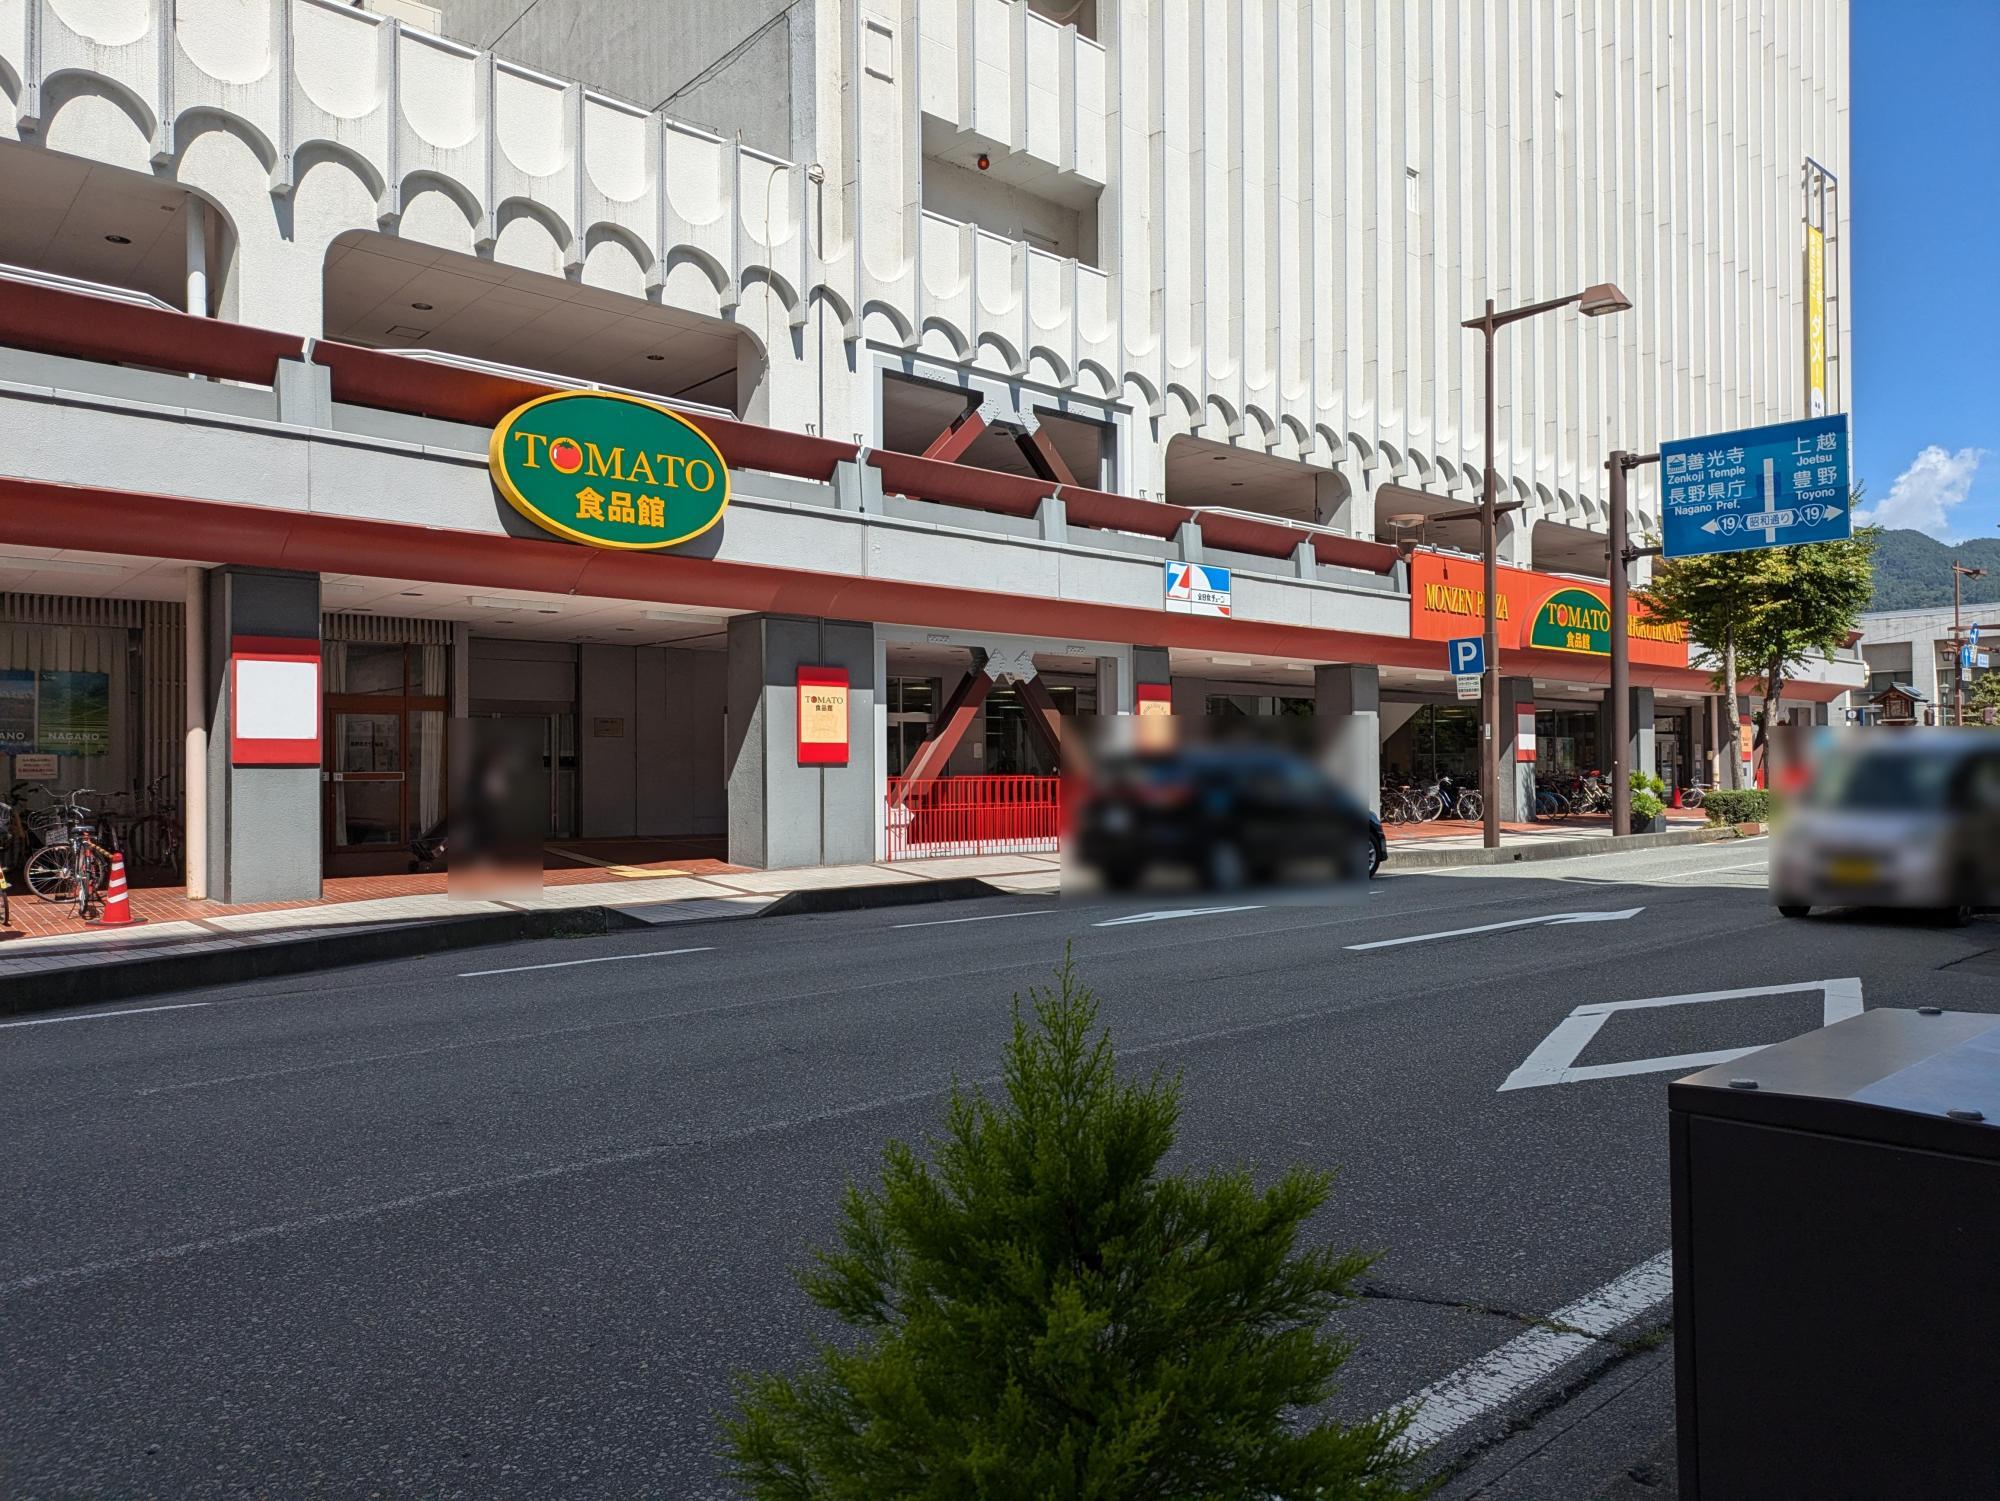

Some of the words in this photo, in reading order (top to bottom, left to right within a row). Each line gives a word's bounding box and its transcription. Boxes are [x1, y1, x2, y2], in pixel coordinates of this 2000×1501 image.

[1792, 432, 1837, 455] 上越
[515, 432, 715, 492] TOMATO
[1687, 447, 1745, 471] 善光寺
[1796, 454, 1833, 467] Joetsu
[1668, 472, 1704, 485] Zenkoji
[1710, 466, 1746, 479] Temple
[1792, 466, 1838, 489] 豊野
[1668, 479, 1746, 506] 長野県庁
[1795, 488, 1836, 501] Toyono
[575, 486, 665, 528] 食品館
[1675, 504, 1712, 516] Nagano
[1716, 500, 1740, 511] Pref.
[1805, 507, 1820, 521] 19
[1721, 517, 1736, 531] 19
[1750, 514, 1791, 528] 昭和通り
[1425, 583, 1473, 616] MONZEN
[1476, 591, 1508, 620] PZA
[1546, 601, 1610, 632] TOMATO
[1566, 631, 1591, 650] 食品館
[1457, 641, 1477, 671] P
[805, 695, 844, 704] TOMATO
[48, 732, 100, 741] NAGANO
